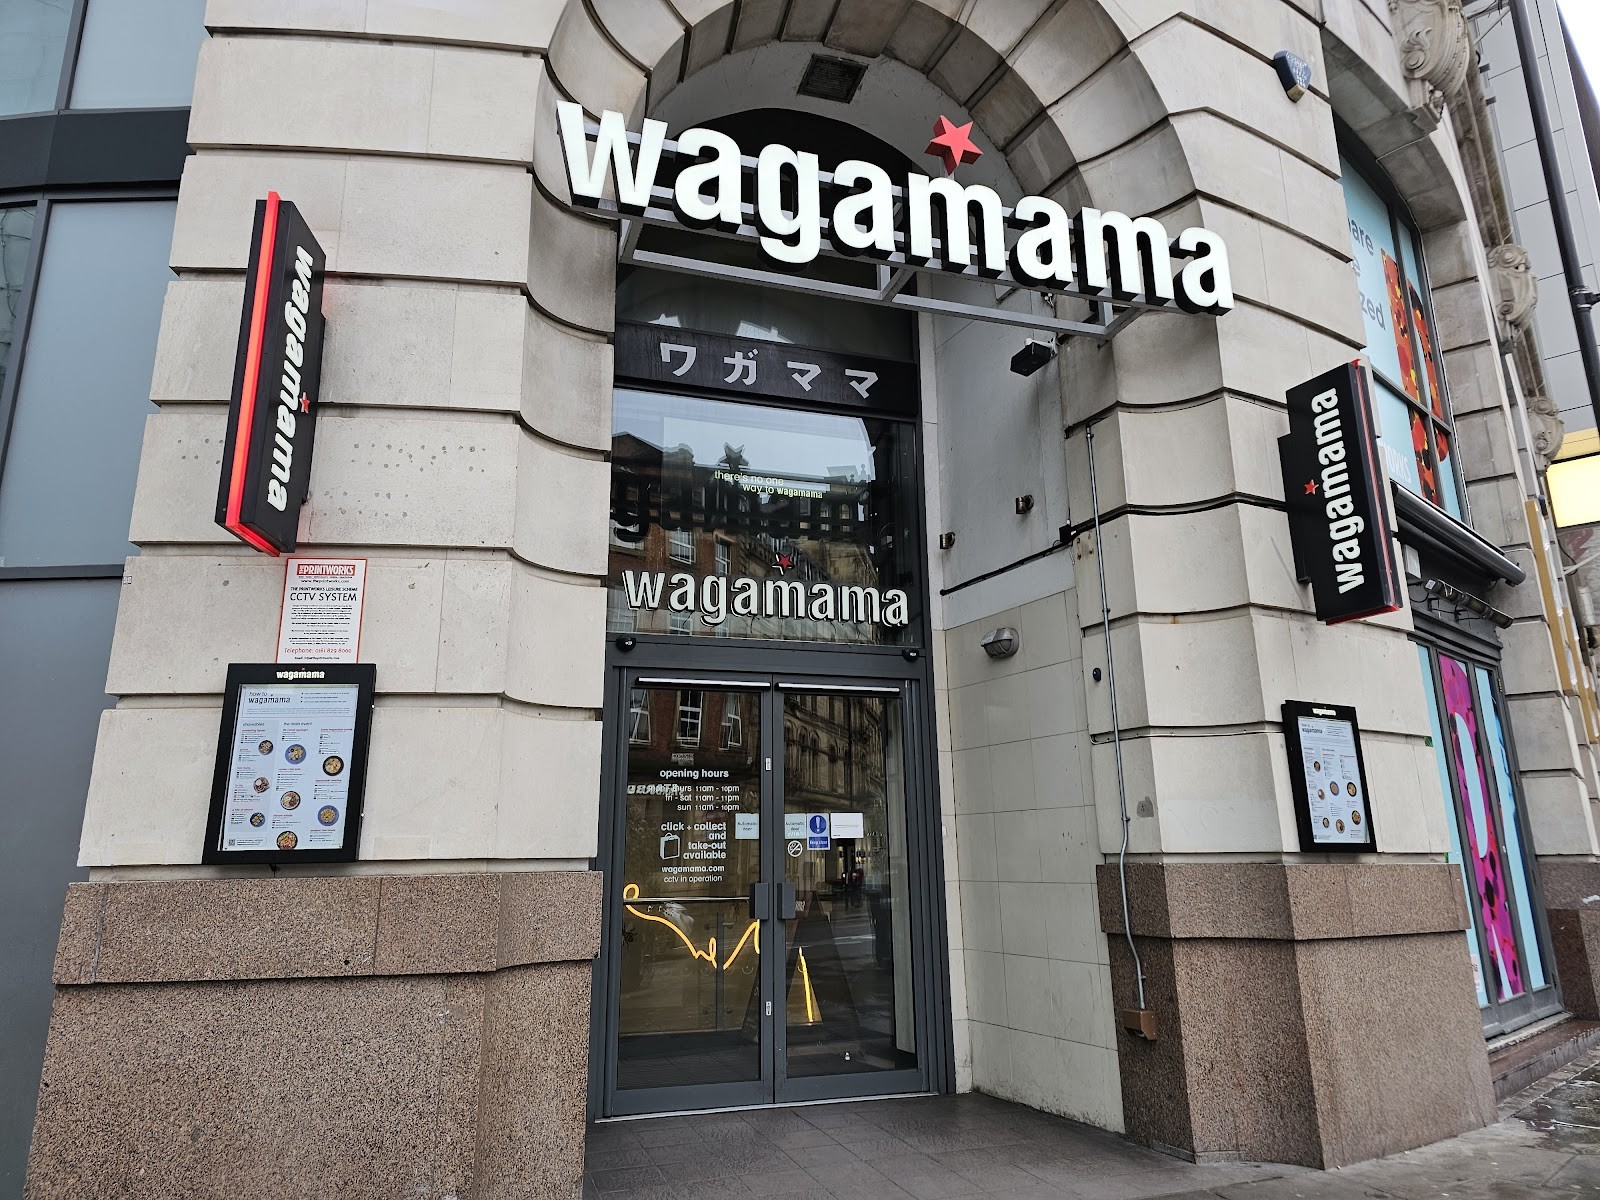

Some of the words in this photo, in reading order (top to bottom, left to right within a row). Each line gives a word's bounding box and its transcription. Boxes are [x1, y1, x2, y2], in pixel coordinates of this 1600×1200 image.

[556, 100, 1235, 313] wagamama
[659, 342, 879, 399] ワガママ
[267, 245, 314, 512] wagamama
[714, 470, 748, 482] there's
[751, 475, 763, 484] no
[766, 477, 784, 485] one
[742, 483, 762, 494] way
[765, 484, 774, 494] to
[776, 488, 823, 499] wagamama
[1311, 387, 1365, 594] wagamama
[304, 565, 353, 575] PRINTWORKS
[290, 592, 316, 600] CCTV
[318, 592, 357, 602] SYSTEM
[622, 569, 909, 626] wagamama
[276, 671, 325, 680] wagamama
[659, 768, 699, 779] opening
[701, 768, 729, 778] hours
[721, 785, 740, 794] 10pm
[664, 793, 673, 802] fri
[679, 793, 692, 802] sat
[721, 795, 740, 803] 11pm
[721, 804, 740, 813] 10pm
[660, 821, 685, 831] click
[693, 821, 727, 831] collect
[708, 830, 727, 840] and
[687, 840, 727, 850] take-out
[682, 850, 727, 860] available
[661, 865, 725, 874] wagamama.com
[663, 874, 679, 883] cctv
[680, 874, 688, 883] in
[688, 874, 723, 883] operation
